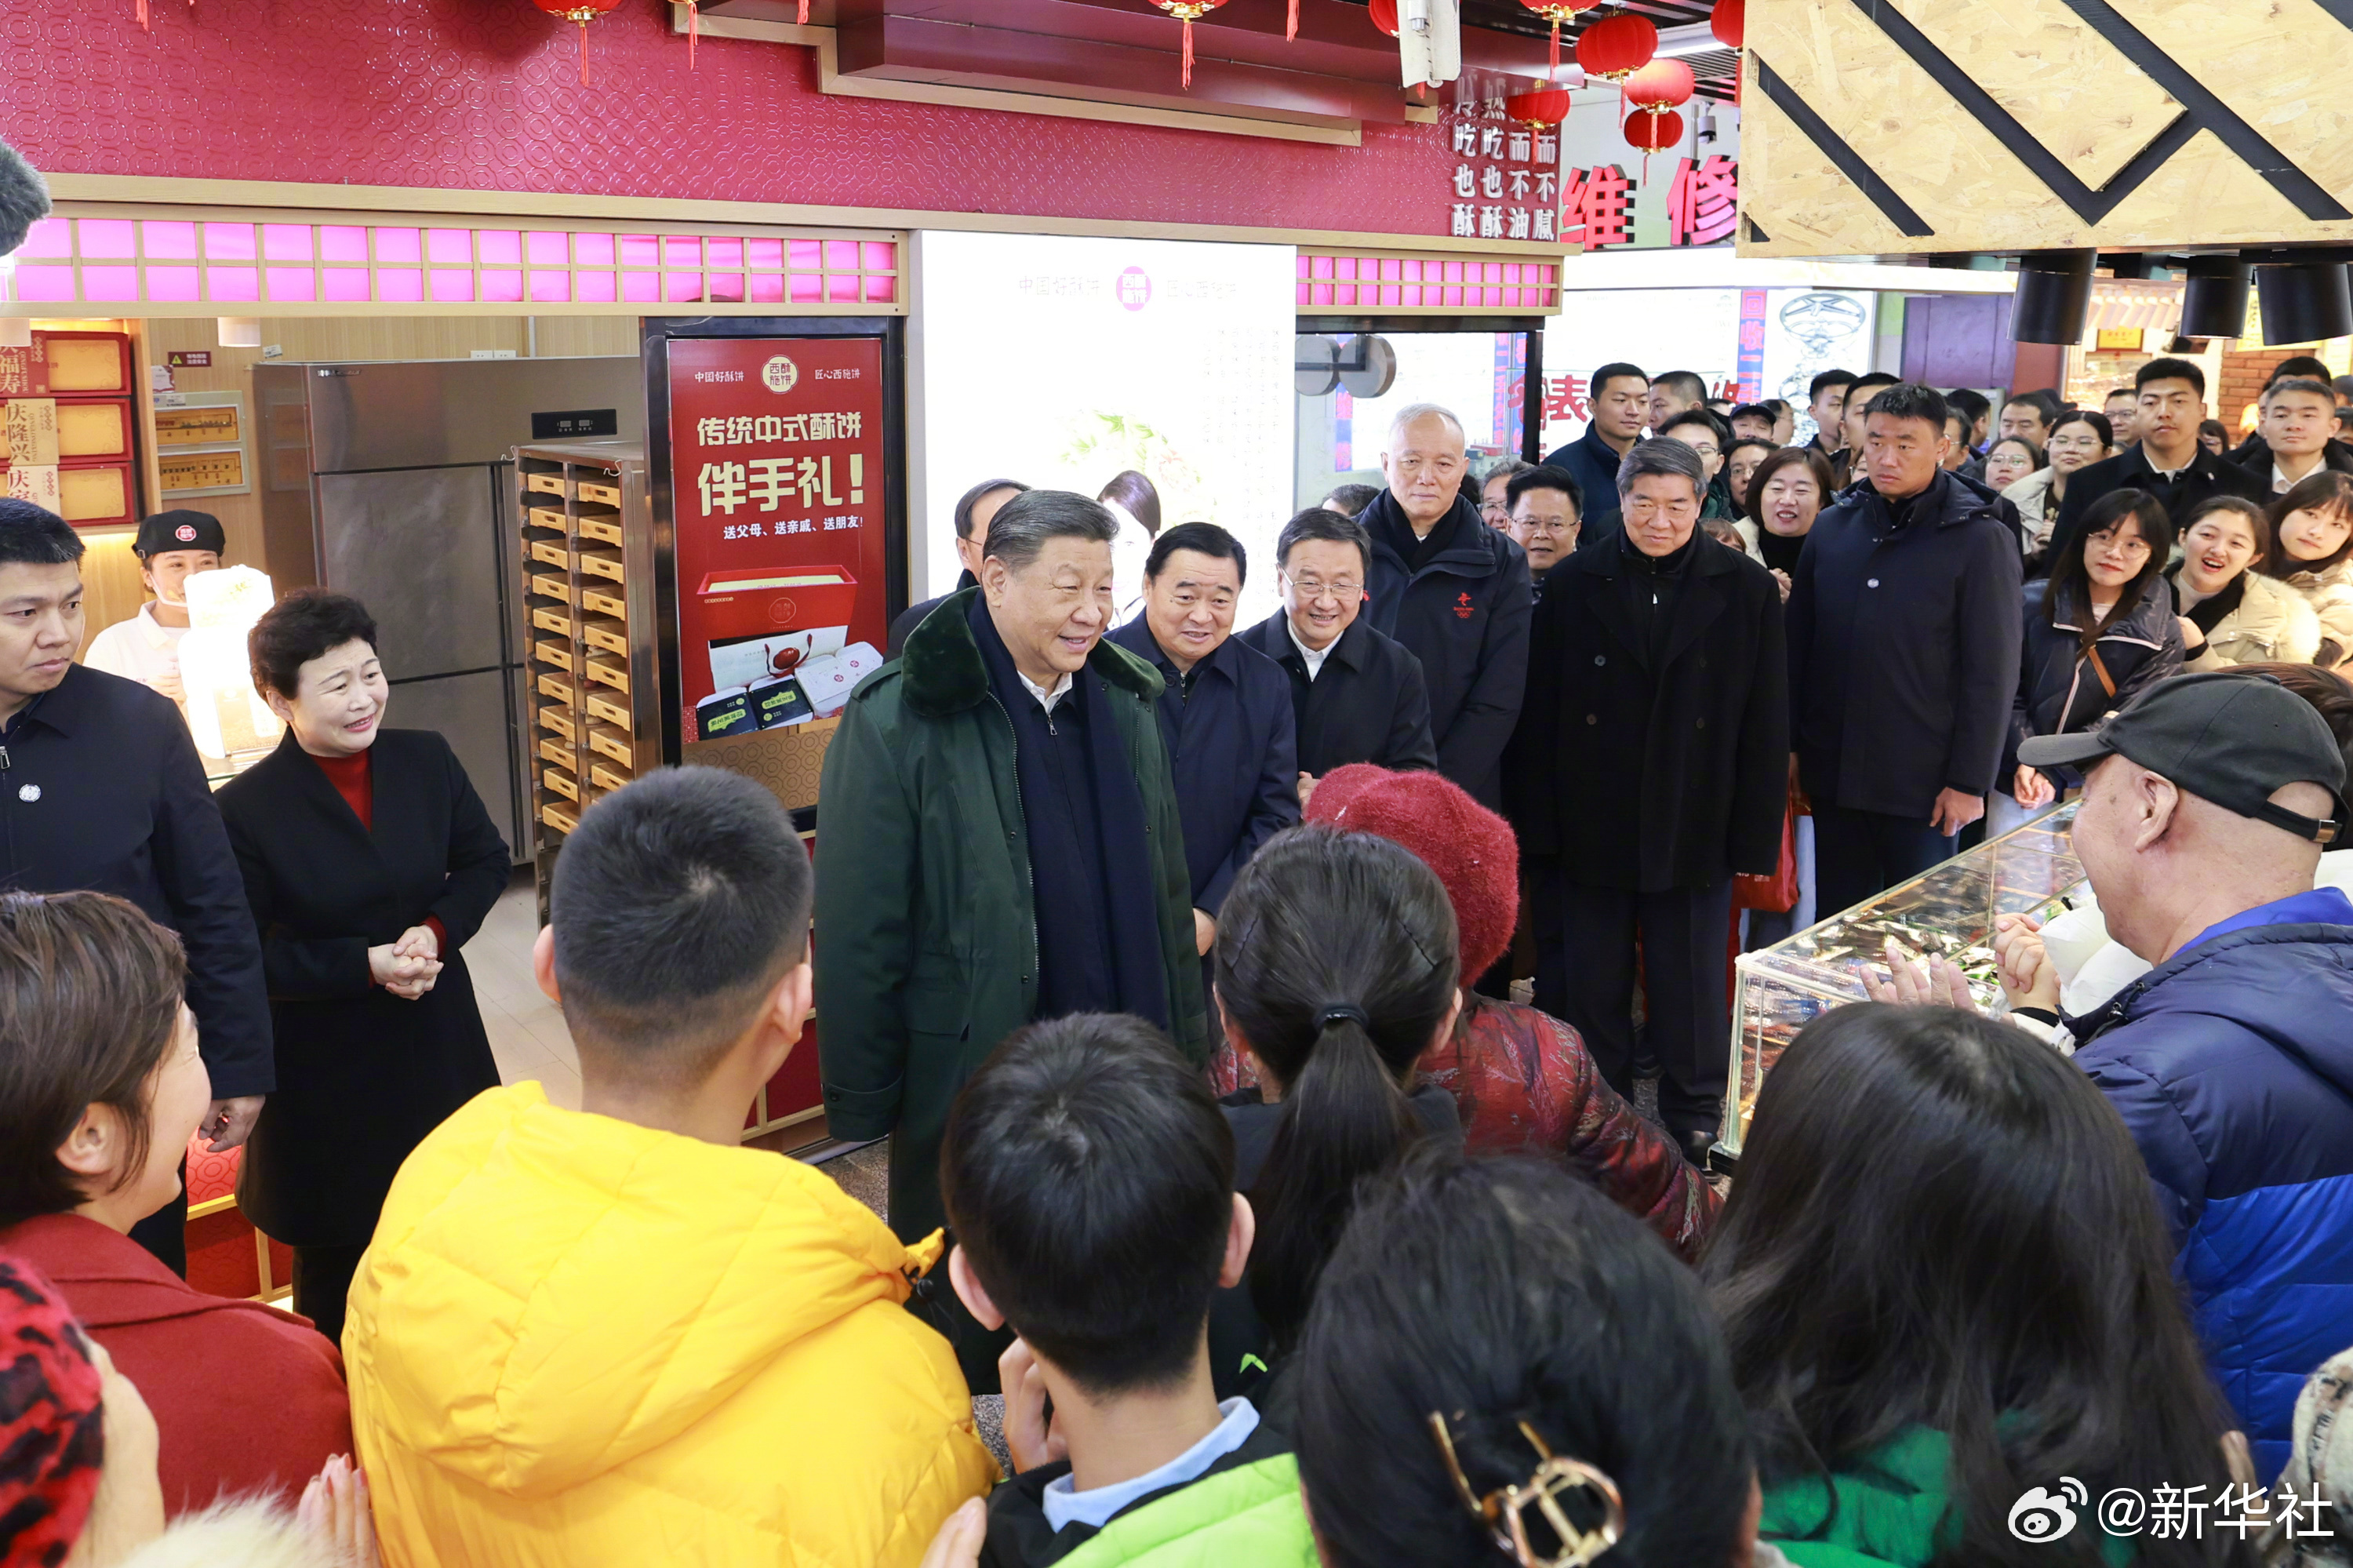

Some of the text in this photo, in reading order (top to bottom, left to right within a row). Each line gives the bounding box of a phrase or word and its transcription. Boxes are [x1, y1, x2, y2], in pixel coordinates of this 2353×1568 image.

[1507, 115, 1530, 240] 而不油
[1532, 124, 1556, 242] 而不腻
[0, 347, 21, 393] 福寿
[694, 370, 744, 383] 中国好酥饼
[814, 368, 861, 380] 匠心西施饼
[6, 403, 30, 462] 庆隆兴
[696, 411, 862, 446] 传统中式酥饼
